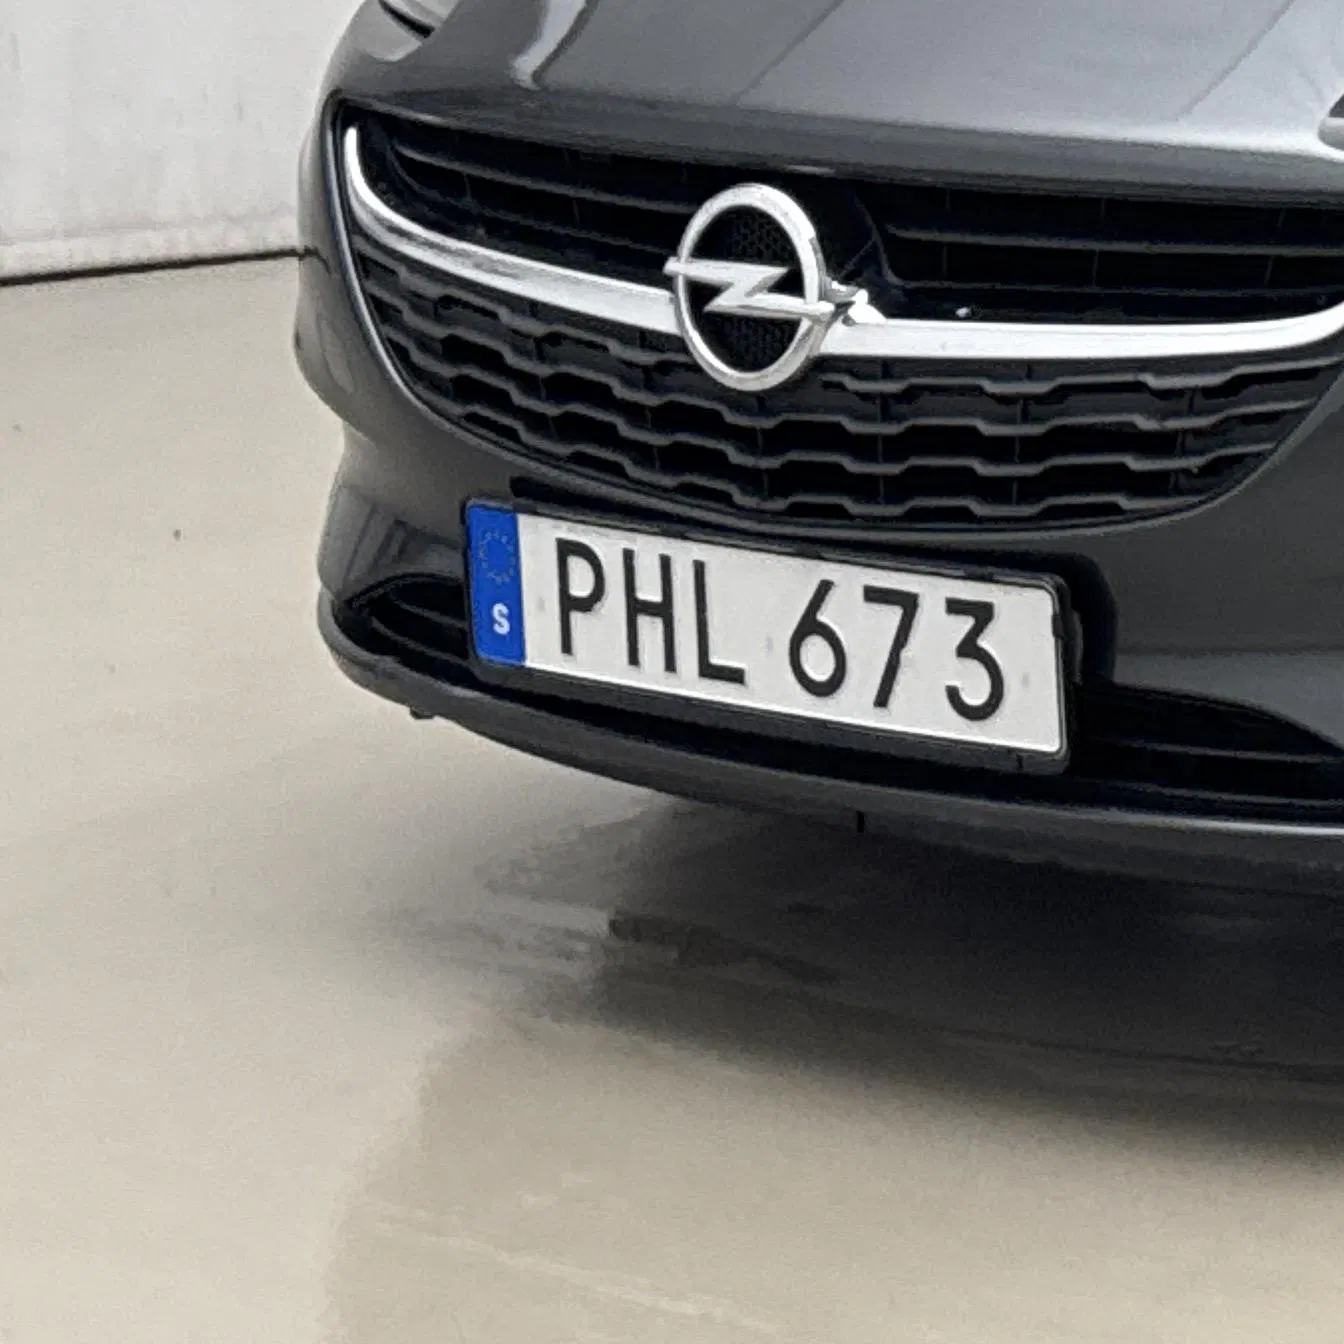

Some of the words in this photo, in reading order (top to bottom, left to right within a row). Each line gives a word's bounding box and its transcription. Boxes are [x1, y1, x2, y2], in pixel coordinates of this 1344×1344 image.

[492, 602, 511, 635] S
[555, 536, 746, 686] PHL
[788, 579, 1005, 722] 673
